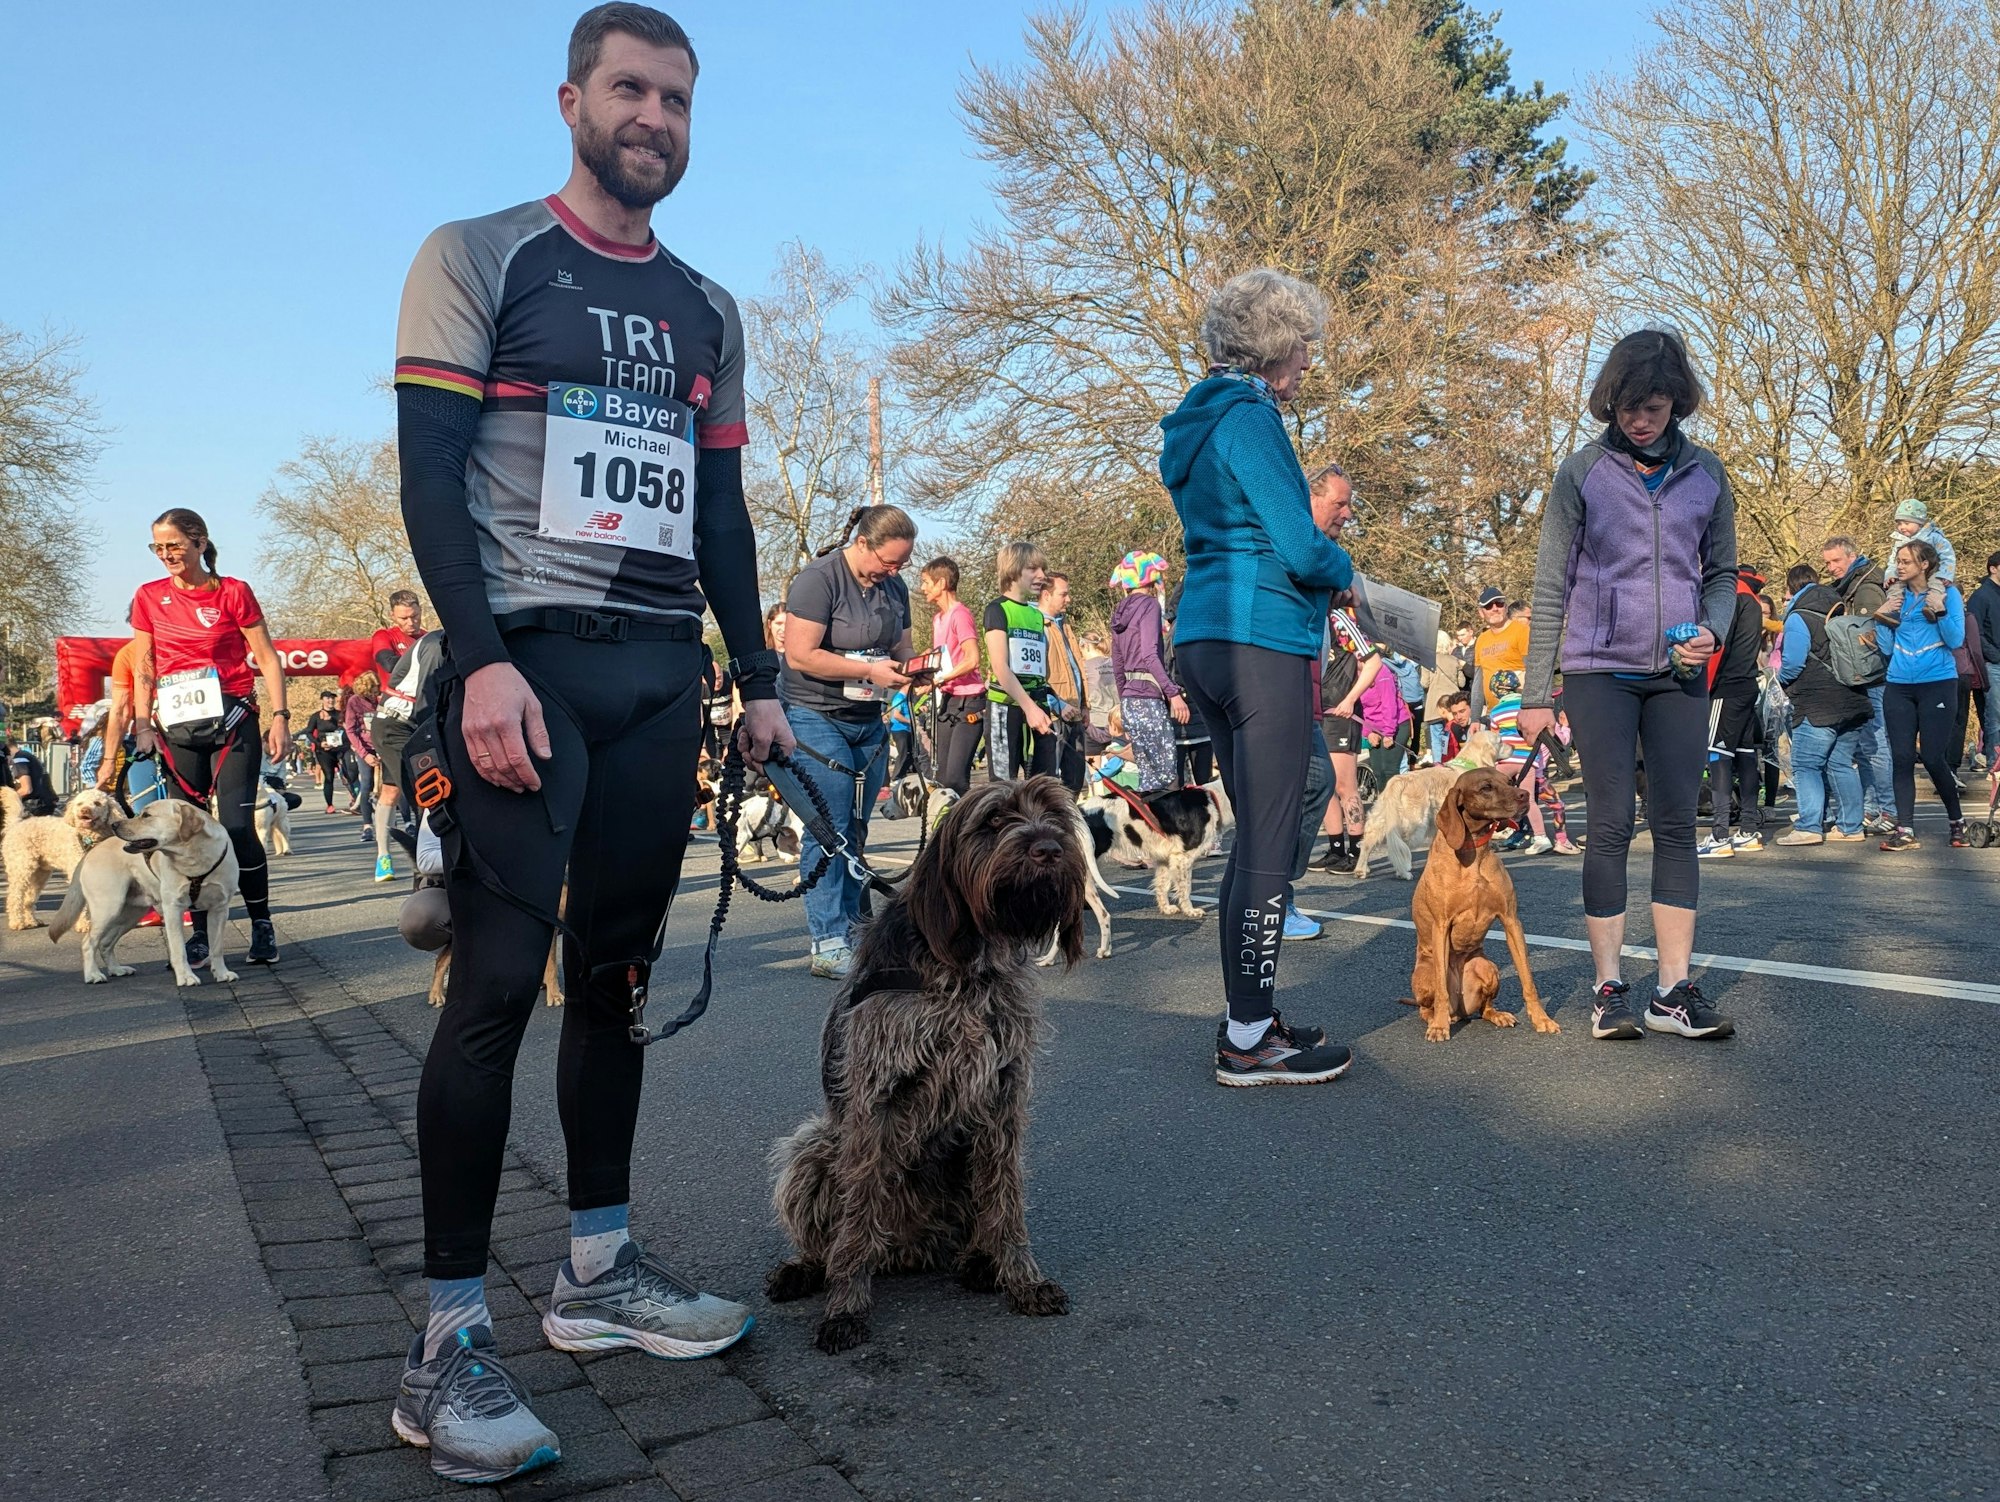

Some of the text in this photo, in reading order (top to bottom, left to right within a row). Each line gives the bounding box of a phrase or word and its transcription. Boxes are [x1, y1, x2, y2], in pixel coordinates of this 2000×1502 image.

[587, 306, 675, 364] TRi
[601, 356, 676, 398] TEAM
[566, 398, 595, 407] BAYER
[605, 394, 678, 430] Bayer
[604, 429, 671, 456] Michael
[573, 451, 685, 515] 1058
[575, 530, 593, 538] new
[594, 531, 627, 542] balance
[1023, 630, 1039, 640] Bayer
[1021, 647, 1042, 663] 389
[171, 671, 201, 683] Bayer
[171, 689, 206, 710] 340
[1240, 908, 1260, 976] BEACH
[1259, 893, 1283, 989] VENICE
